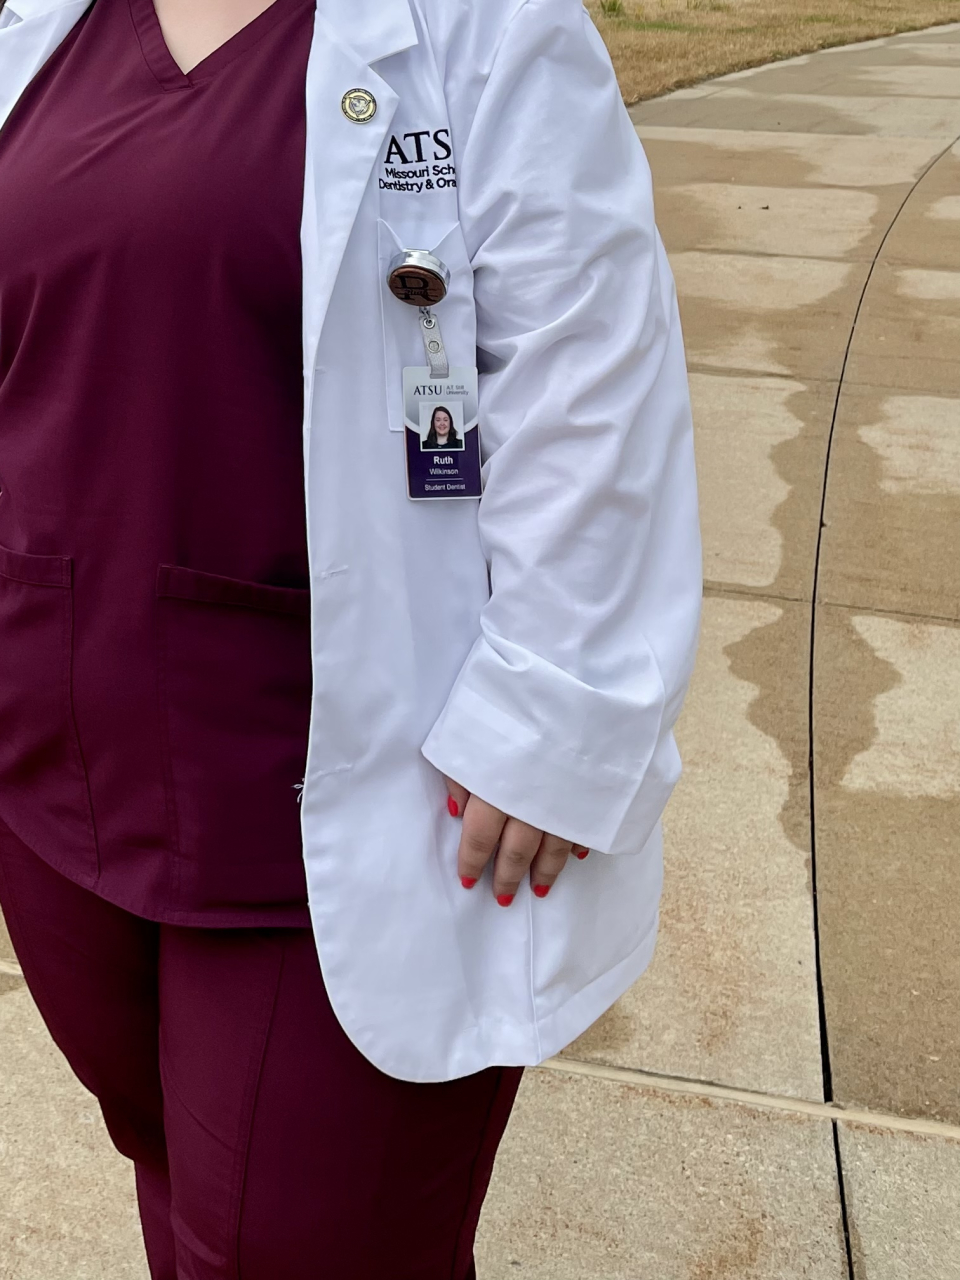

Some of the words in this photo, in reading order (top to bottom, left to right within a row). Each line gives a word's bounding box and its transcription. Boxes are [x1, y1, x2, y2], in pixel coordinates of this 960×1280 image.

[384, 129, 451, 164] ATS
[385, 166, 429, 179] Missouri
[378, 177, 424, 193] Dentistry
[425, 178, 435, 190] &
[413, 384, 443, 396] ATSU
[433, 455, 454, 465] Ruth
[429, 468, 459, 476] Wilkinson
[424, 483, 446, 491] Student
[446, 483, 466, 491] Dentist
